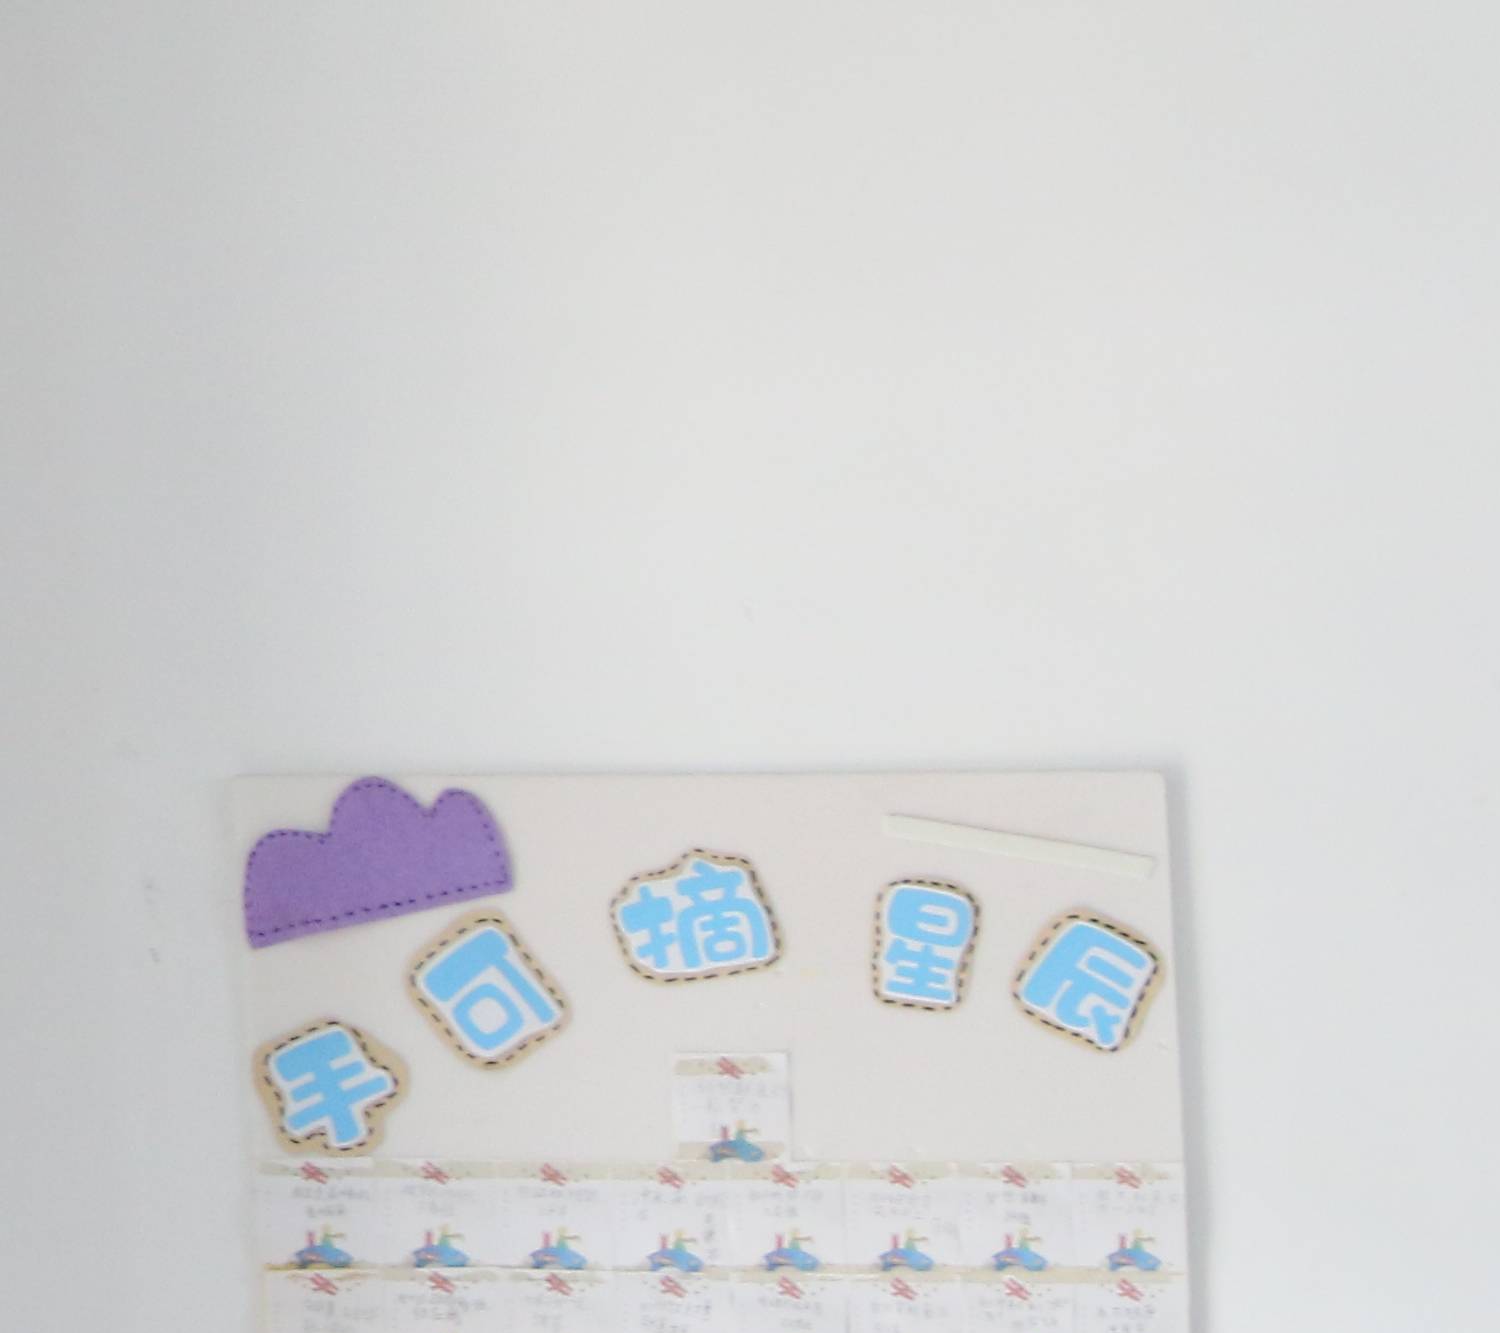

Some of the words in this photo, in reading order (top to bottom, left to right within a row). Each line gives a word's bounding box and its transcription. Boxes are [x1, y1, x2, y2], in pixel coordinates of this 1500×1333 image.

[270, 862, 1159, 1146] 手可摘星辰
